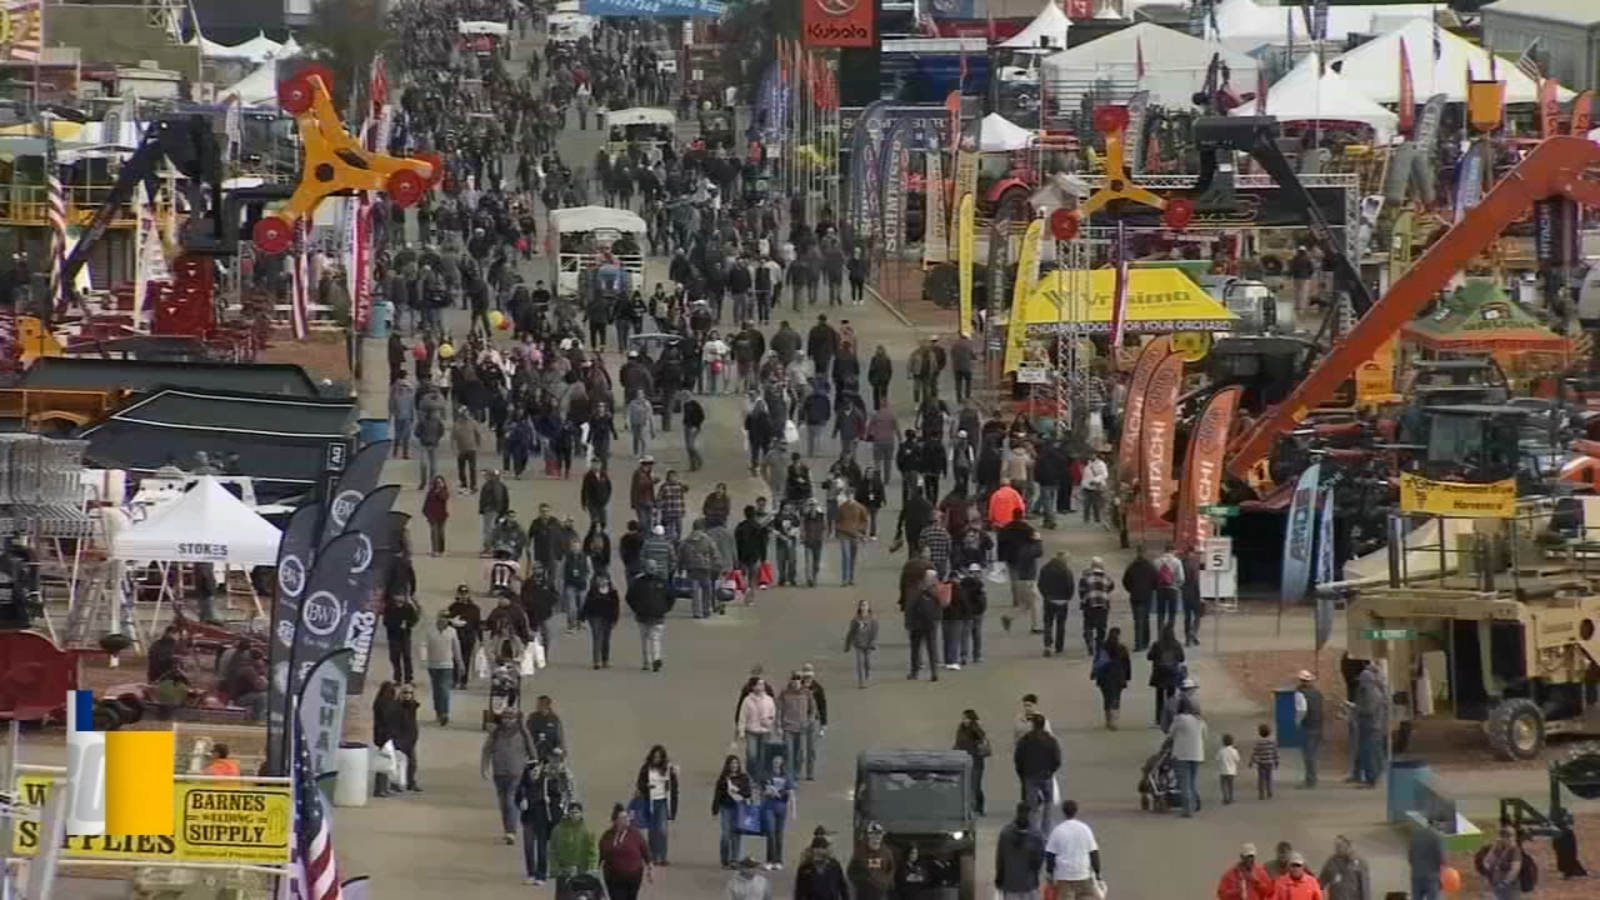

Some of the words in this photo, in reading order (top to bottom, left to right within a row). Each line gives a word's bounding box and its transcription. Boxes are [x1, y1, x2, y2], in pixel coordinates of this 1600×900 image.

[808, 24, 867, 39] Kubota
[1080, 290, 1191, 305] Vrsimo
[1150, 421, 1166, 509] HITACHI
[178, 543, 227, 555] STOKES
[1213, 555, 1223, 567] 5
[192, 793, 266, 811] BARNES
[189, 825, 265, 843] SUPPLY
